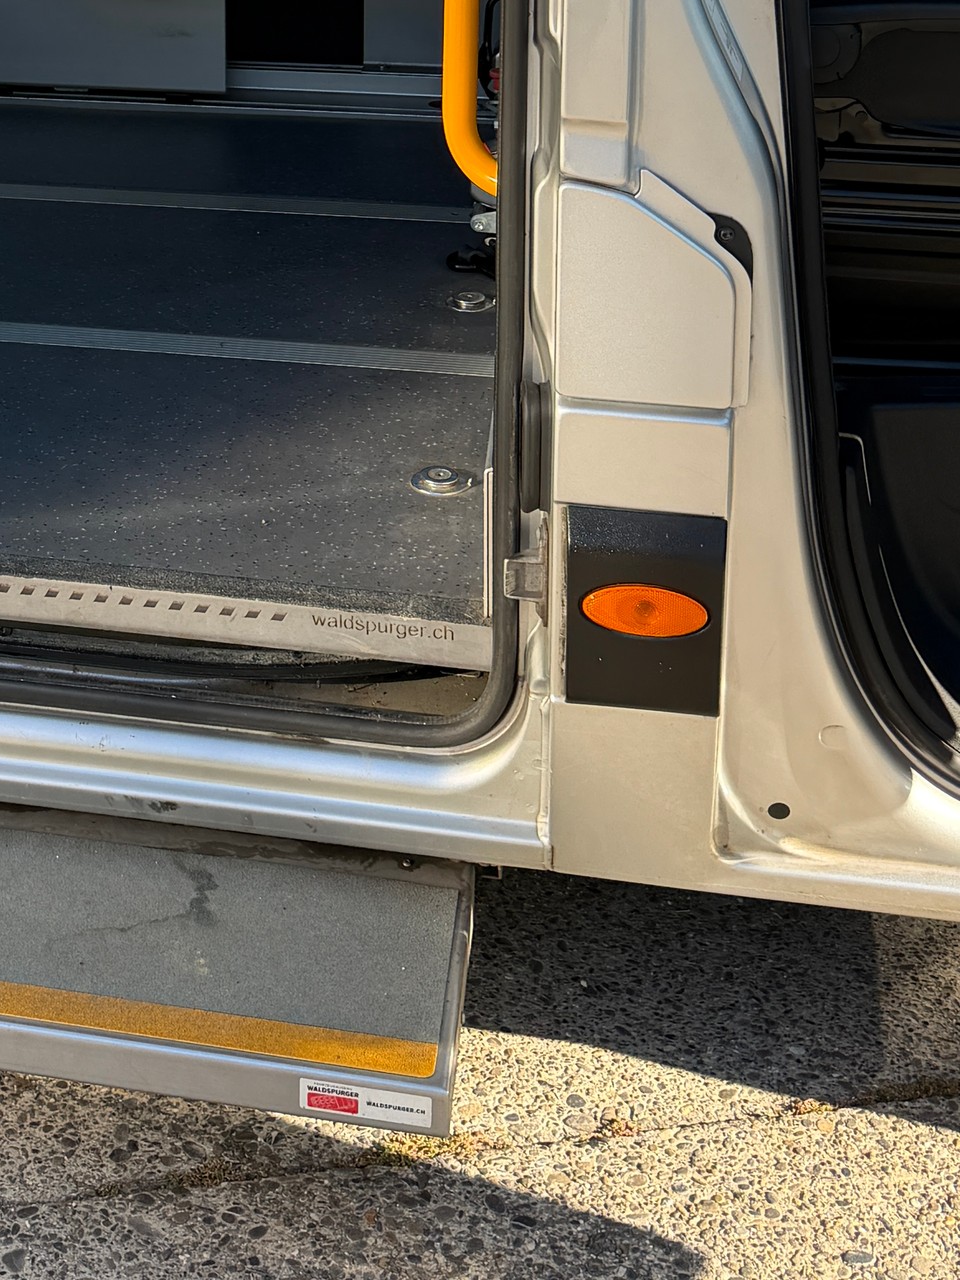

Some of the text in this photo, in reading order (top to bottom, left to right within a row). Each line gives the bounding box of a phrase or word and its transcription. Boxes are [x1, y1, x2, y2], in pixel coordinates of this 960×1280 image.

[312, 614, 455, 641] waldspurger.ch
[307, 1085, 359, 1098] WALDSPURGER
[366, 1101, 426, 1115] WALDSPURGER.CH
